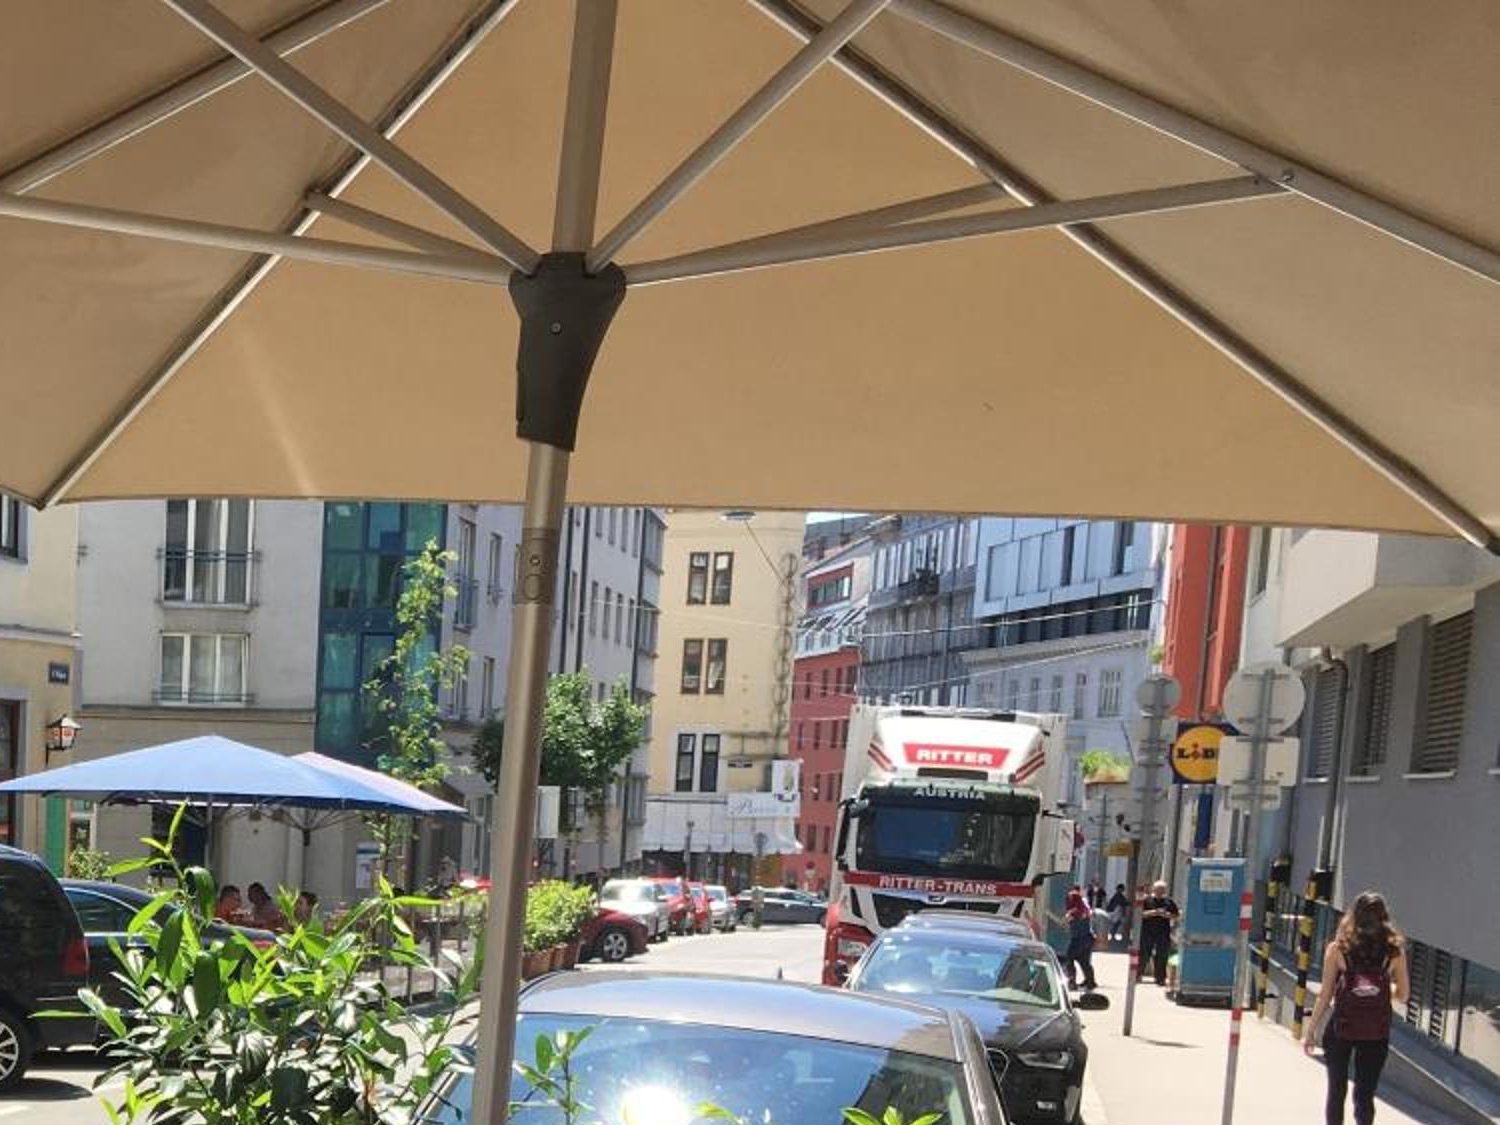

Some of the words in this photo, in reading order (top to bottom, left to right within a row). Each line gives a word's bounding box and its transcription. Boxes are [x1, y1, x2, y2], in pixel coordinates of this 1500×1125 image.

[916, 749, 994, 764] RITTER
[913, 787, 986, 801] AUSTRIA
[878, 876, 998, 895] RITTER-TRANS
